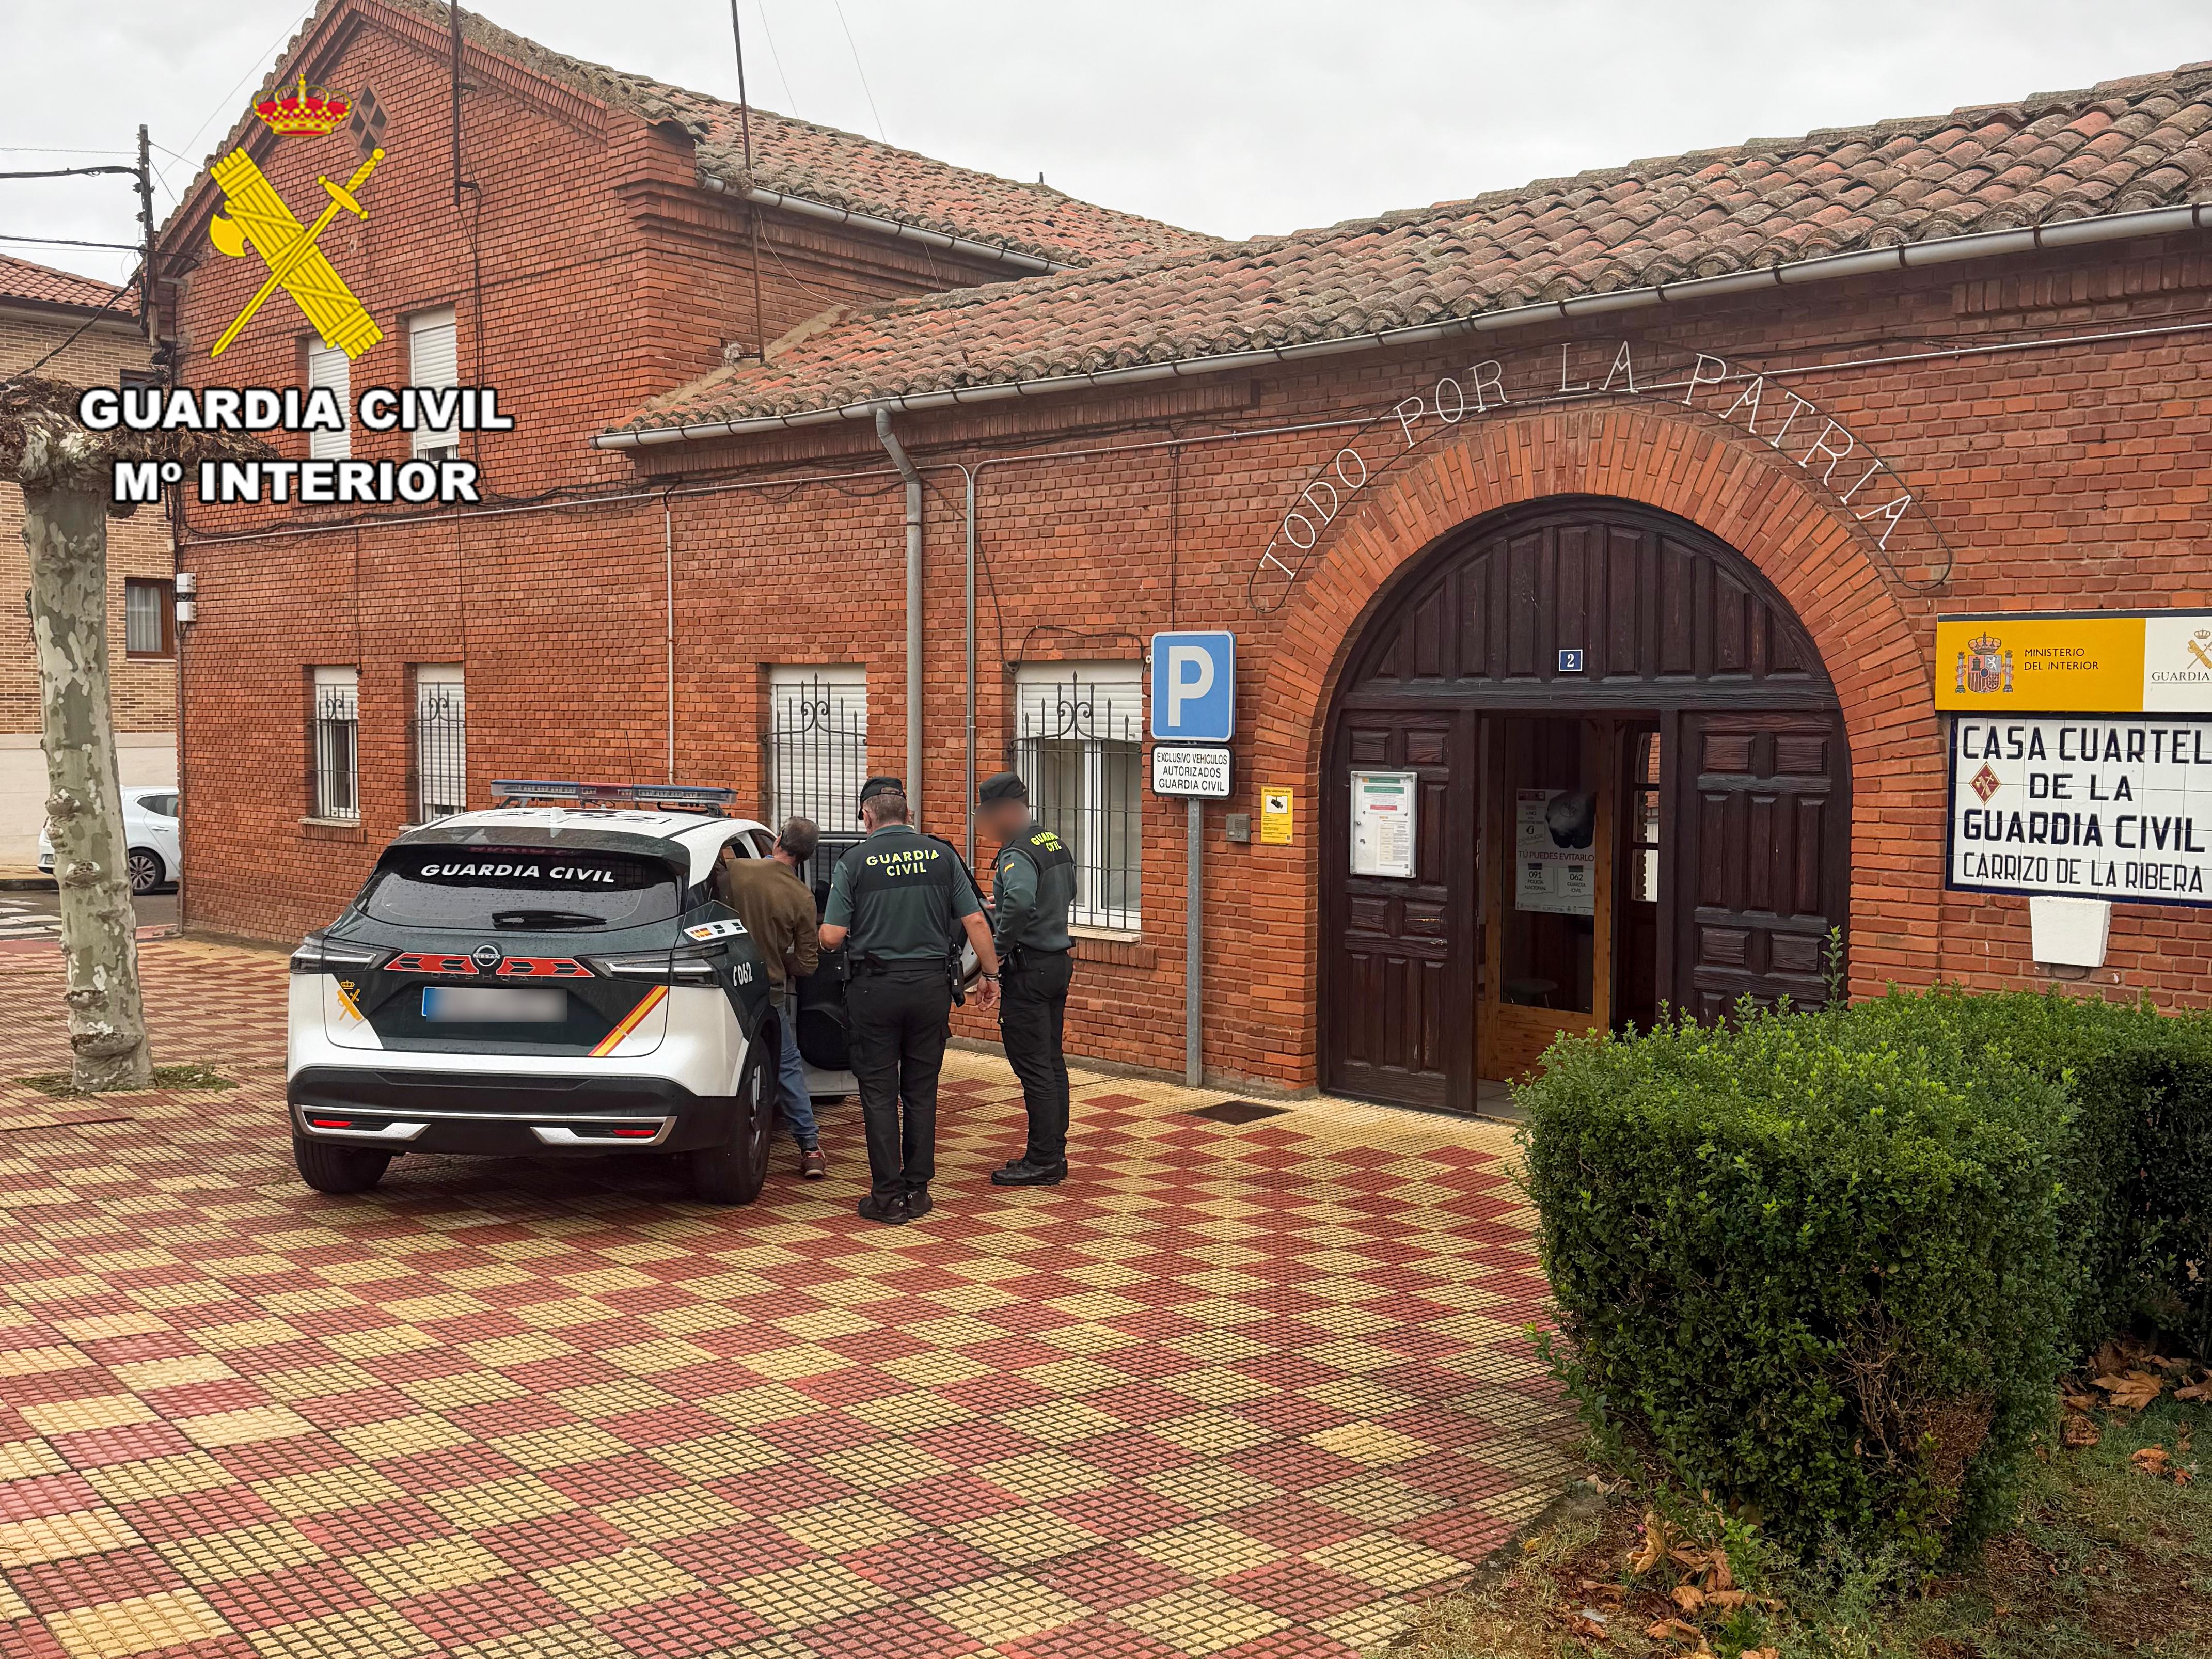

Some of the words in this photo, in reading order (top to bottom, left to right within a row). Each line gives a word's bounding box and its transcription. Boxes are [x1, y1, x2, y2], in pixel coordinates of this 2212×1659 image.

[1259, 448, 1366, 580] TODO
[1393, 360, 1509, 448] POR
[1559, 340, 1639, 393] LA
[1682, 353, 1911, 551] PATRIA
[2025, 648, 2085, 657] MINISTERIO
[1567, 653, 1574, 668] 2
[2024, 661, 2043, 670] DEL
[2048, 661, 2099, 670] INTERIOR
[2152, 672, 2210, 682] GUARDIA
[1168, 646, 1214, 727] P
[1963, 725, 2047, 761] CASA
[2059, 727, 2212, 764] CUARTEL
[1157, 752, 1191, 763] EXCLUSIVO
[1192, 754, 1227, 765] VEHICULOS
[1163, 766, 1221, 778] AUTORIZADOS
[1159, 778, 1199, 790] GUARDIA
[1202, 780, 1225, 792] CIVIL
[2030, 772, 2073, 799] DE
[2090, 774, 2133, 801] LA
[1964, 809, 2103, 847] GUARDIA
[2115, 814, 2205, 852] CIVIL
[866, 849, 940, 866] GUARDIA
[1518, 849, 1528, 858] TÚ
[1529, 851, 1558, 860] PUEDES
[1559, 852, 1594, 862] EVITARLO
[421, 864, 540, 877] GUARDIA
[549, 867, 614, 883] CIVIL
[886, 862, 927, 876] CIVIL
[1964, 852, 2048, 882] CARRIZO
[2057, 858, 2081, 884] DE
[2091, 859, 2116, 887] LA
[2125, 861, 2203, 893] RIBERA
[1569, 873, 1583, 881] 062
[431, 973, 544, 982] QASHQAI
